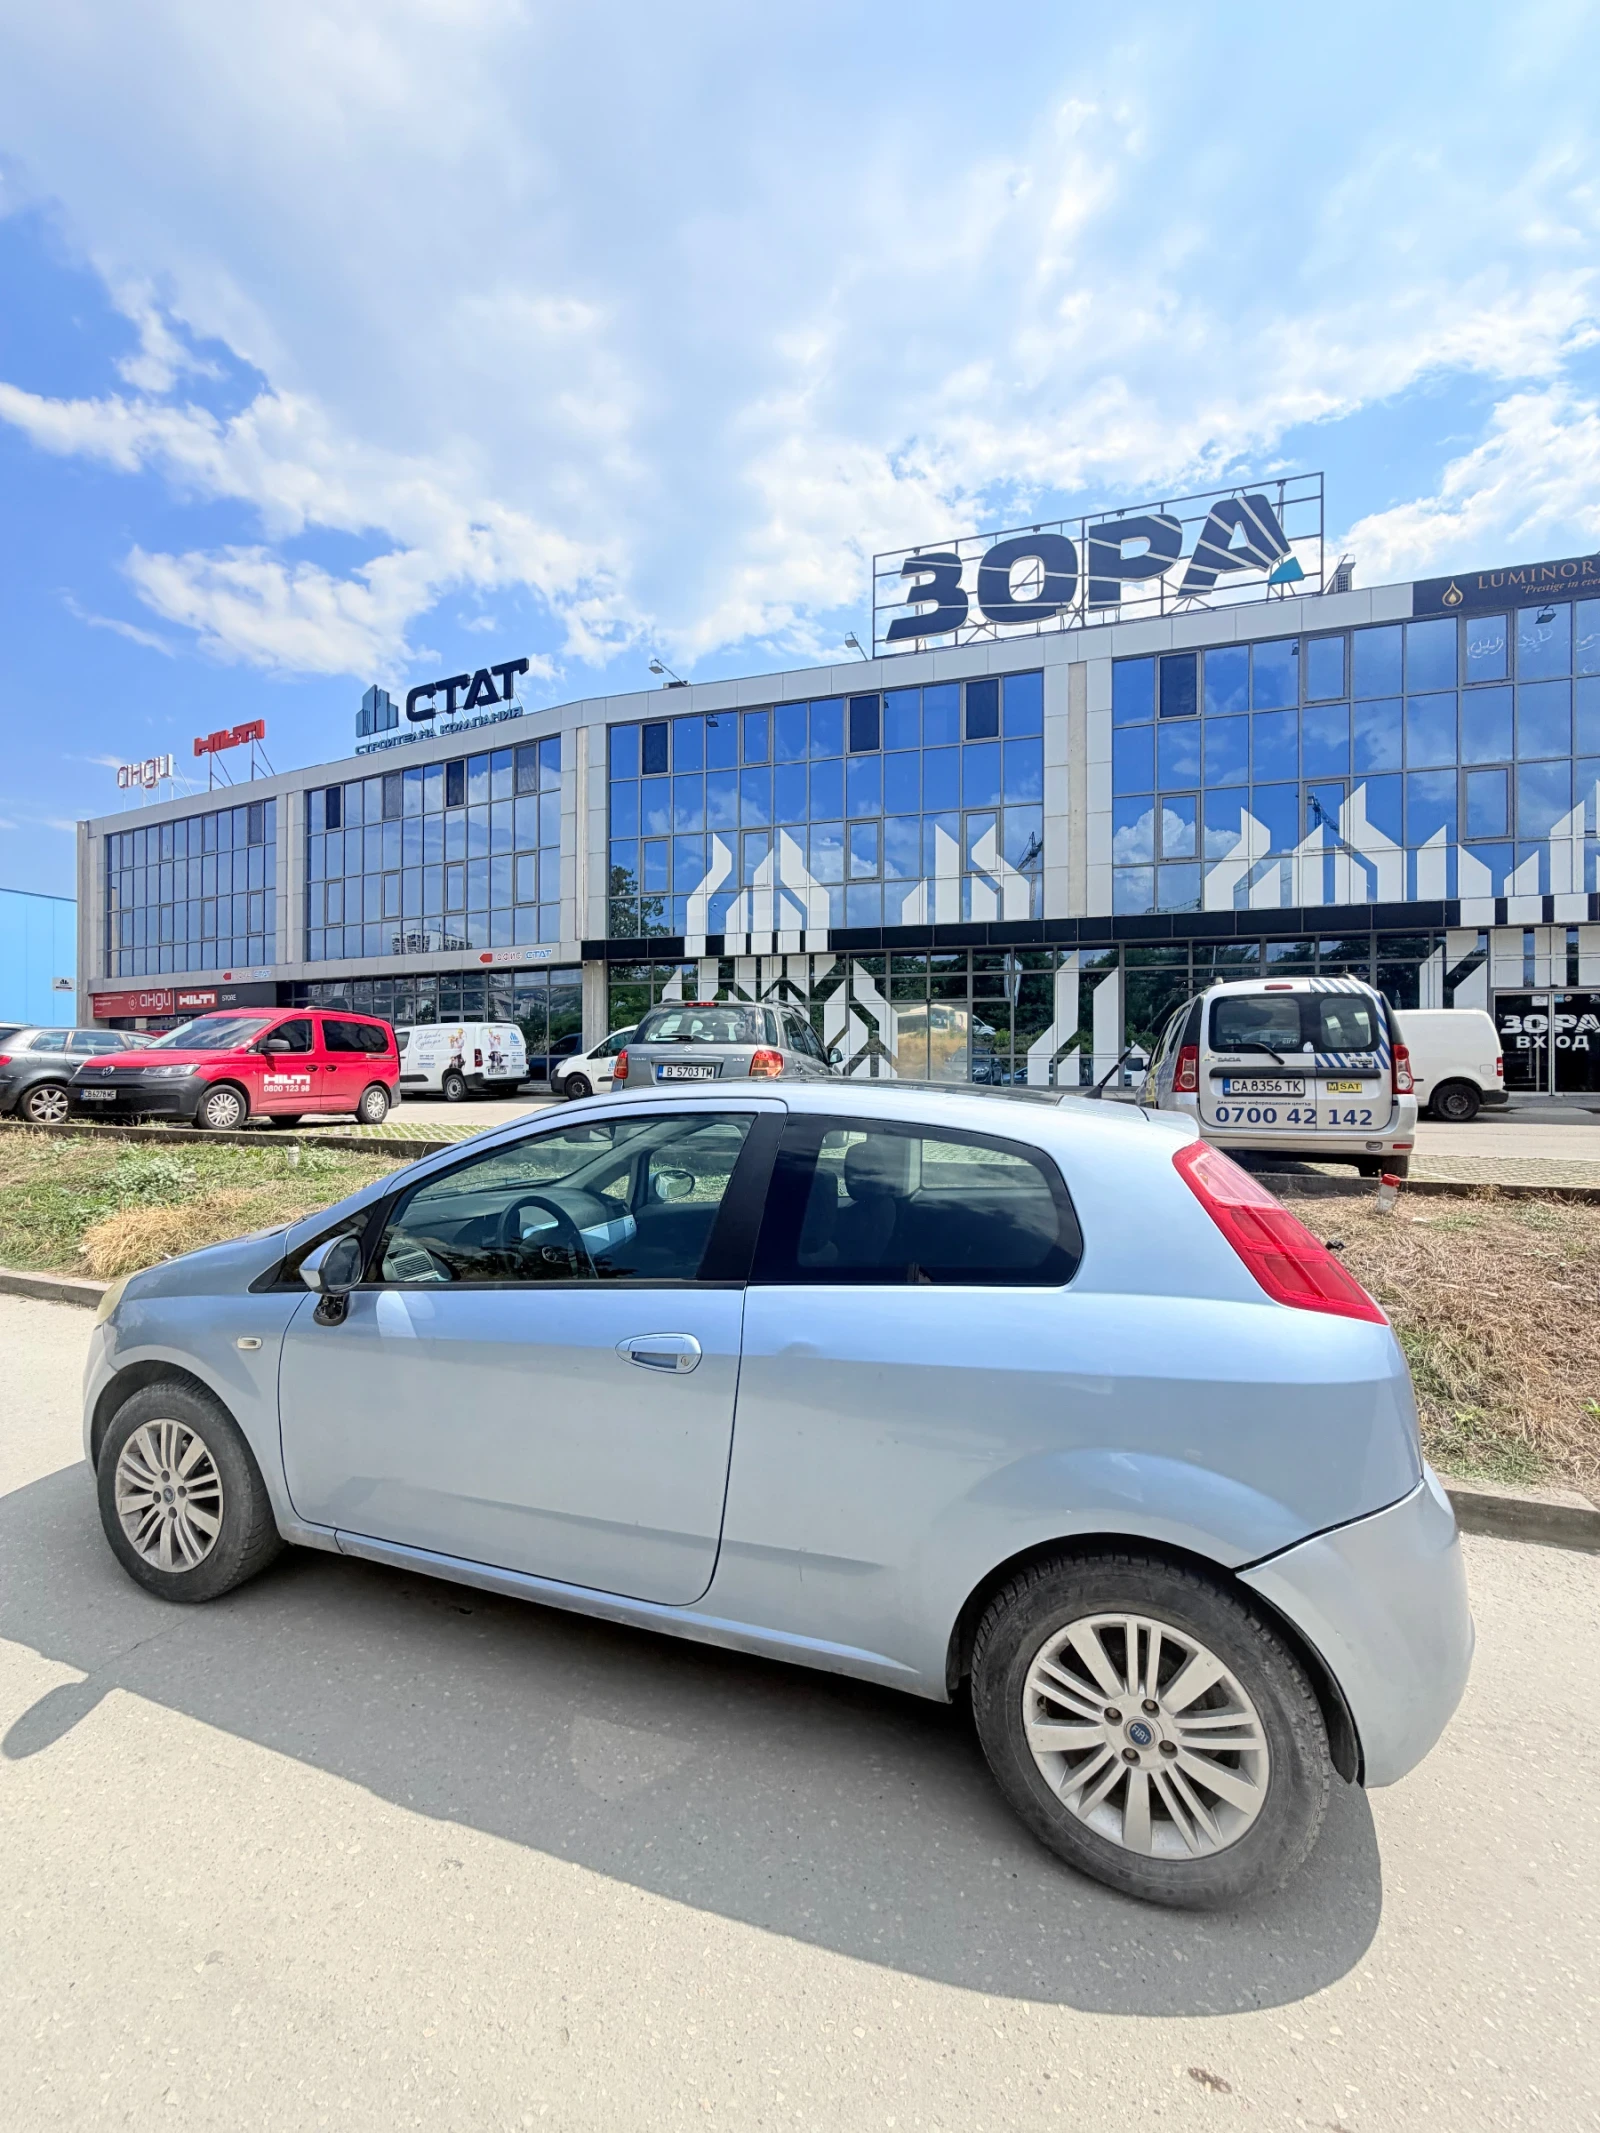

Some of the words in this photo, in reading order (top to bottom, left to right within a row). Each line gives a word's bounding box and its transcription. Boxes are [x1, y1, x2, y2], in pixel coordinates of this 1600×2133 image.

[884, 494, 1292, 644] ЗОРА
[1478, 560, 1598, 590] LUMINOR
[1567, 580, 1579, 588] in
[406, 657, 529, 722] СТАТ
[439, 706, 524, 735] КОМПАНИЯ
[194, 719, 265, 757] HILTI
[179, 993, 215, 1006] HILTI
[1500, 1013, 1600, 1034] ЗОРА
[1516, 1035, 1590, 1051] ВХОД
[264, 1074, 311, 1084] HILTI
[676, 1067, 699, 1077] 5703
[1284, 1080, 1301, 1092] TK
[1216, 1107, 1277, 1124] 0700
[1286, 1108, 1316, 1125] 42
[1328, 1109, 1373, 1126] 142
[1131, 1724, 1150, 1743] FIAT
